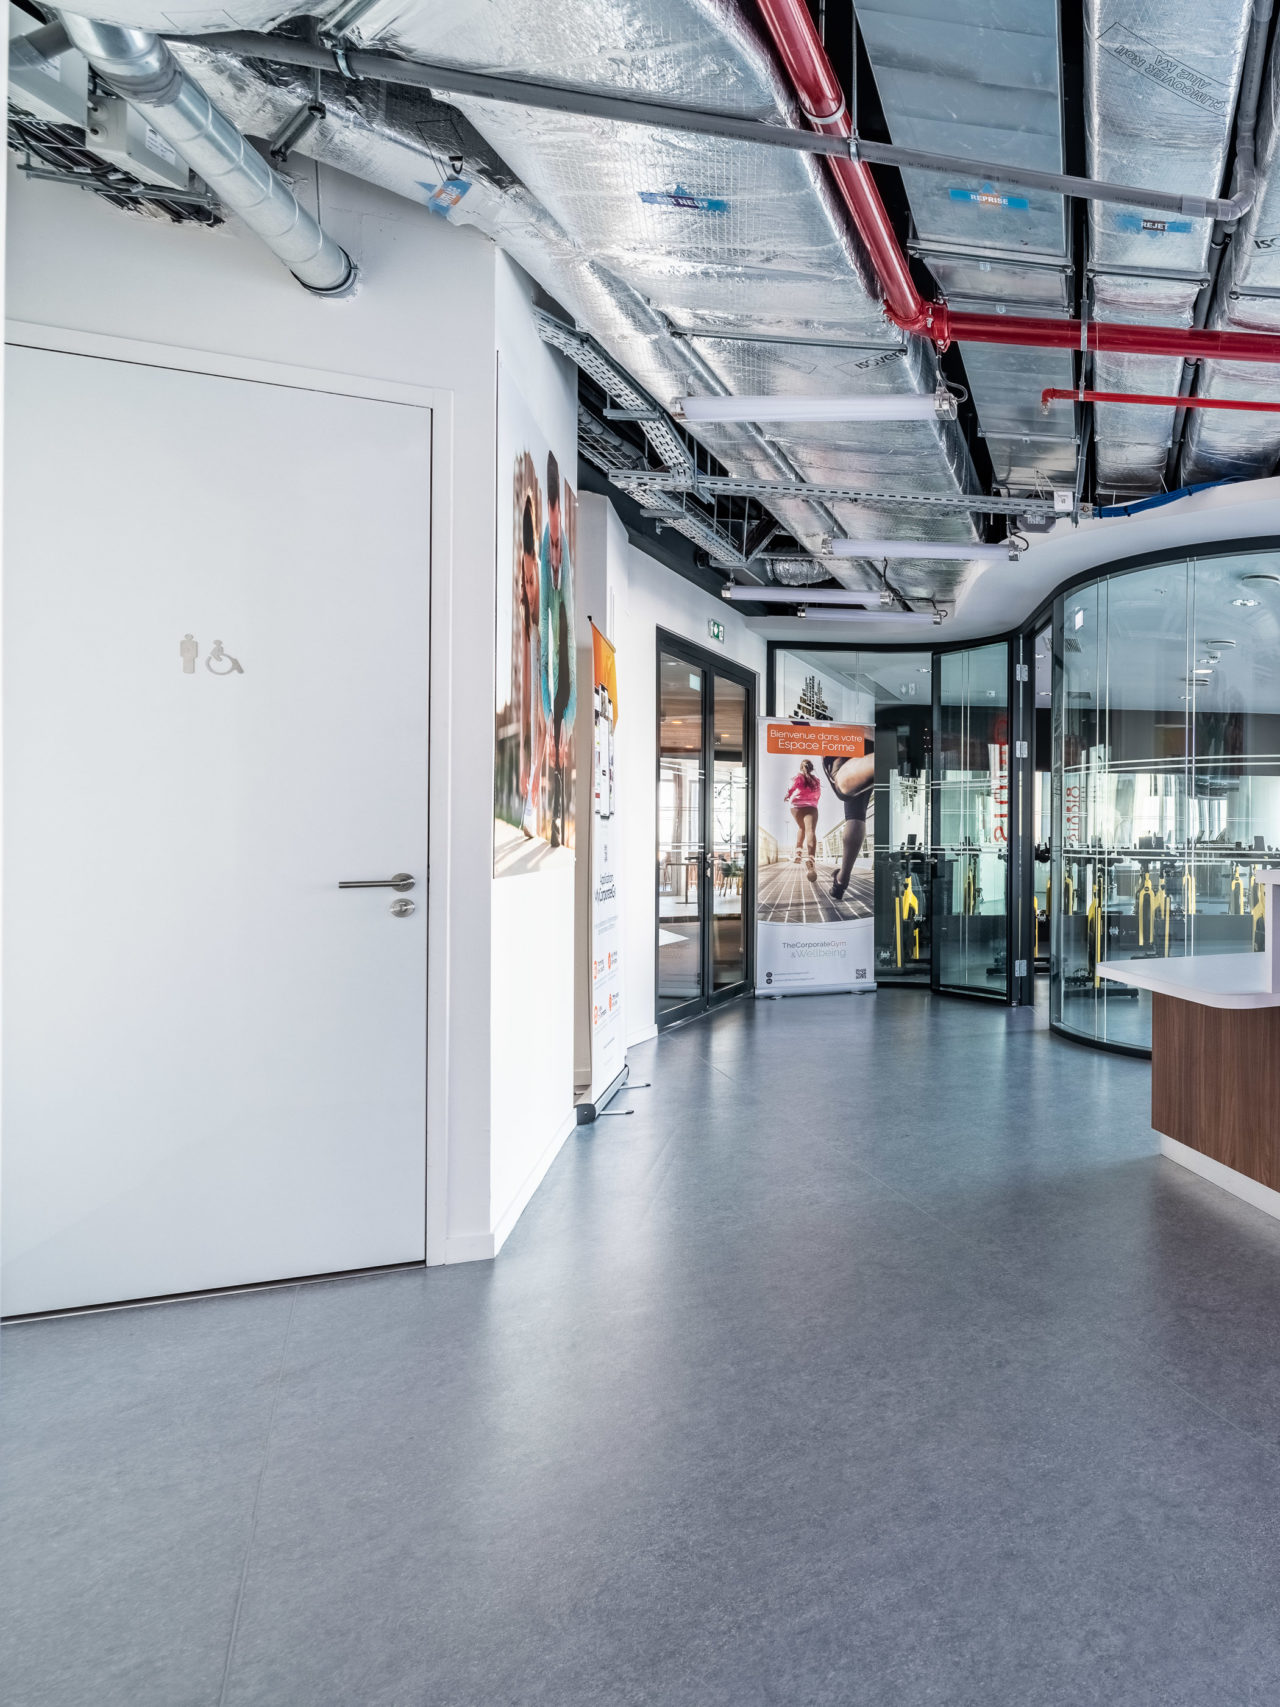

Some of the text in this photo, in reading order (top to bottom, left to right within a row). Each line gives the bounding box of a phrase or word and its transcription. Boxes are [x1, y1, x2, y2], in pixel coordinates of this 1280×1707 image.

[1113, 44, 1226, 111] CLIMCOVER Roll
[1154, 54, 1212, 90] Alu2 KA
[970, 194, 1008, 205] REPRISE
[1141, 221, 1168, 230] REJET
[770, 729, 863, 743] Bienvenue dans votre
[778, 739, 856, 752] Espace Forme
[782, 941, 847, 949] TheCorporateGym
